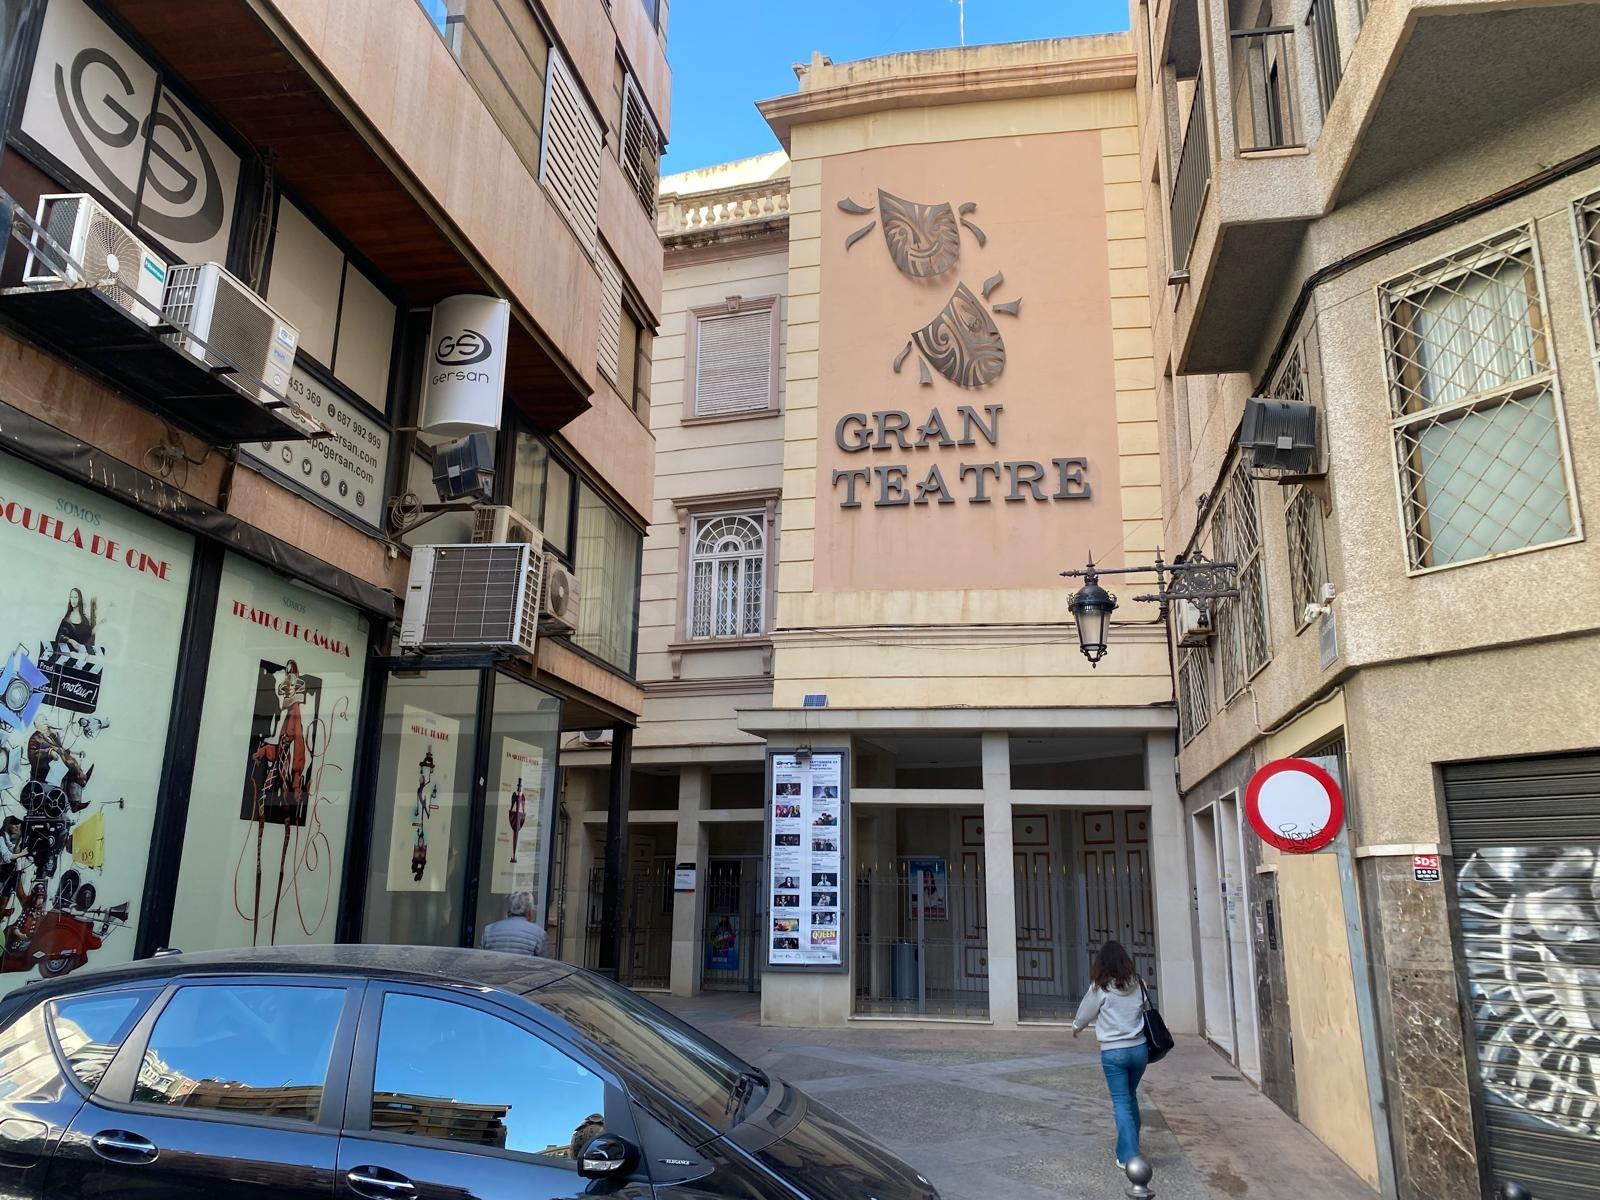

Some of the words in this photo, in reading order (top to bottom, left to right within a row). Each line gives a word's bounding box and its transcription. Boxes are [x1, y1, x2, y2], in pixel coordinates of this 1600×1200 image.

[70, 47, 198, 205] GS
[306, 388, 322, 407] 369
[337, 410, 351, 428] 687
[352, 421, 367, 440] 992
[367, 433, 382, 449] 999
[834, 403, 1004, 452] GRAN
[832, 457, 1092, 508] TEATRE
[56, 497, 103, 526] SOMOS
[90, 534, 120, 562] DE
[125, 548, 172, 582] CINE
[232, 600, 281, 632] TEATRO
[284, 621, 301, 639] DE
[303, 628, 350, 658] CÁMARA
[1414, 856, 1438, 867] SDS
[812, 930, 836, 940] QUEEN
